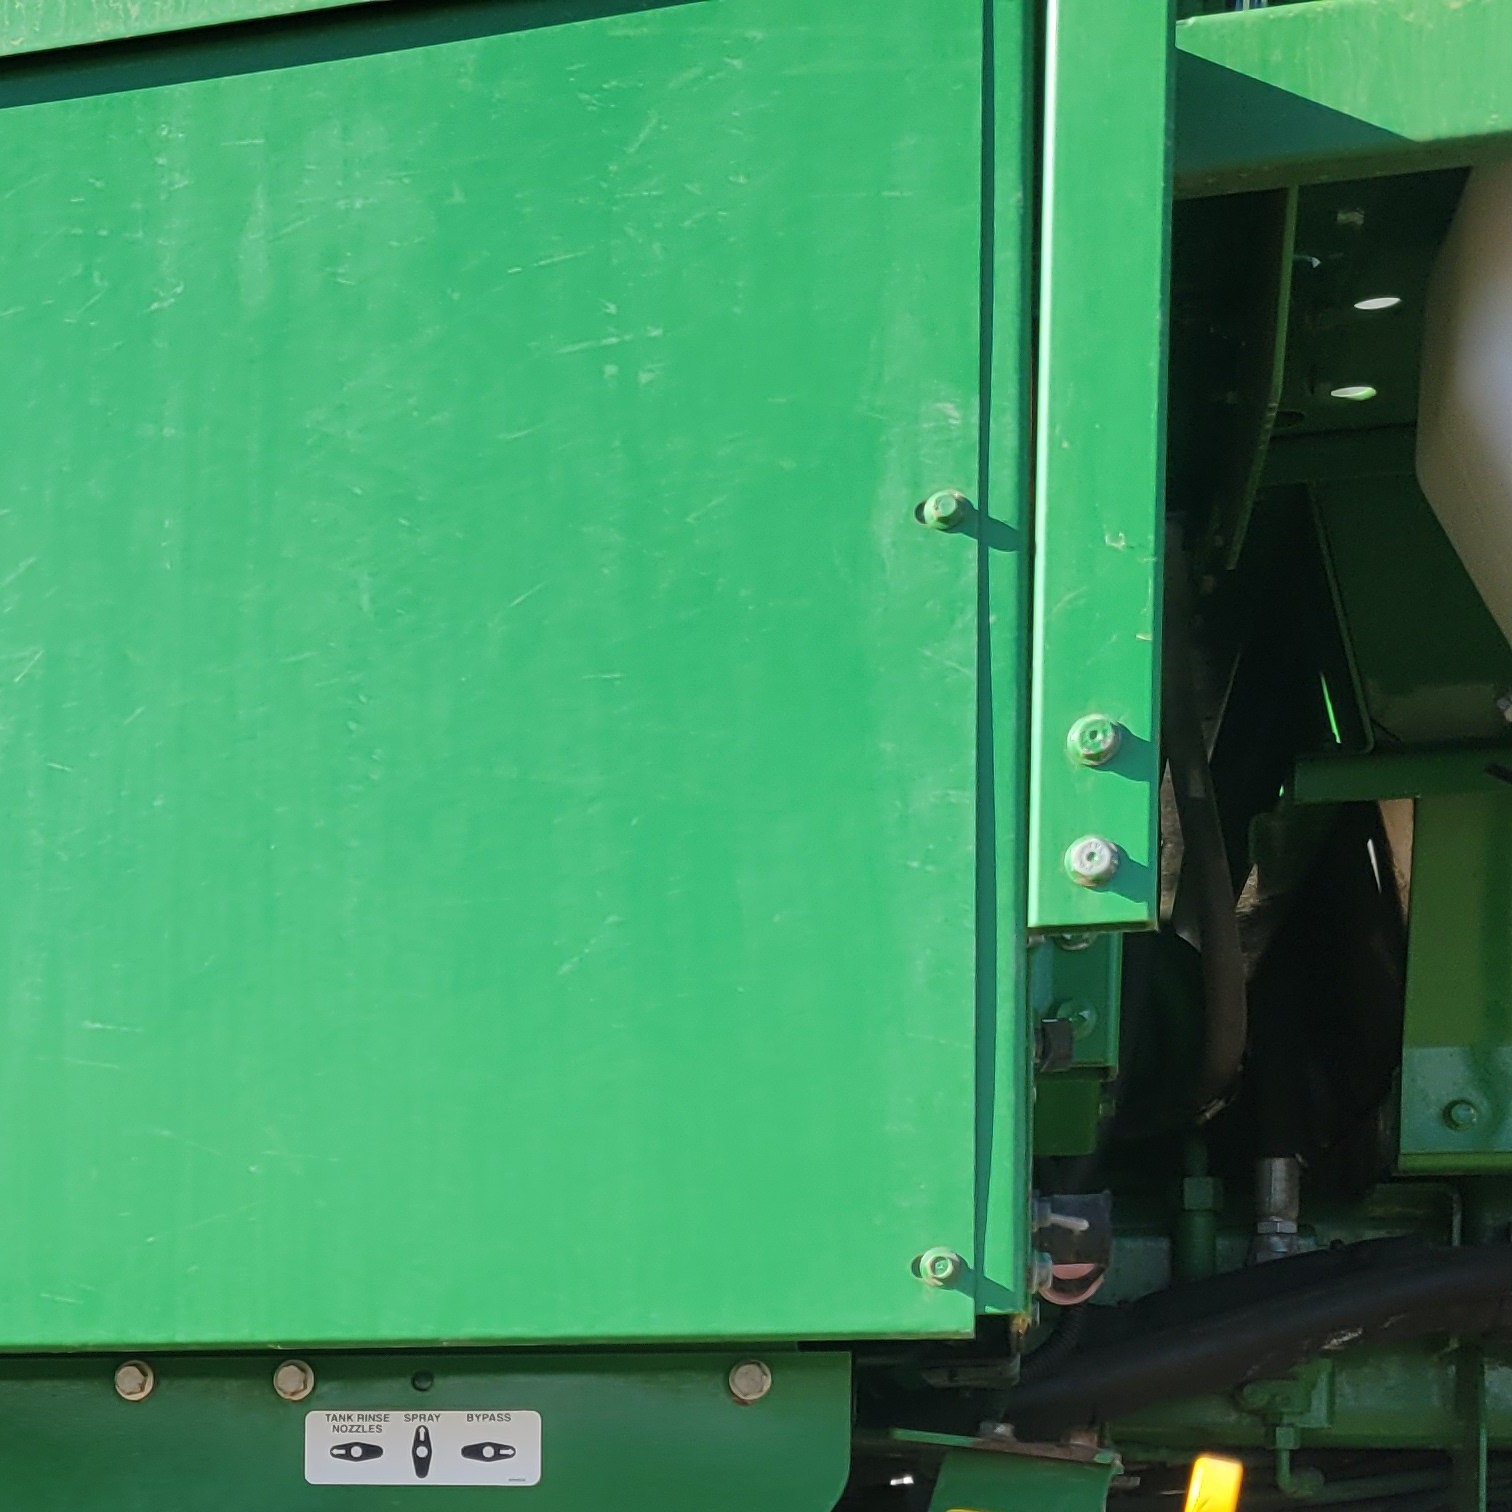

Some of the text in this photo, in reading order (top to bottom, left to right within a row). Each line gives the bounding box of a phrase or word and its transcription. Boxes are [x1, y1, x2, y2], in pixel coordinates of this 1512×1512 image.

[325, 1413, 390, 1422] TANK RINSE
[404, 1414, 441, 1422] SPRAY
[466, 1413, 511, 1422] BYPASS
[332, 1424, 383, 1433] NOZZLES
